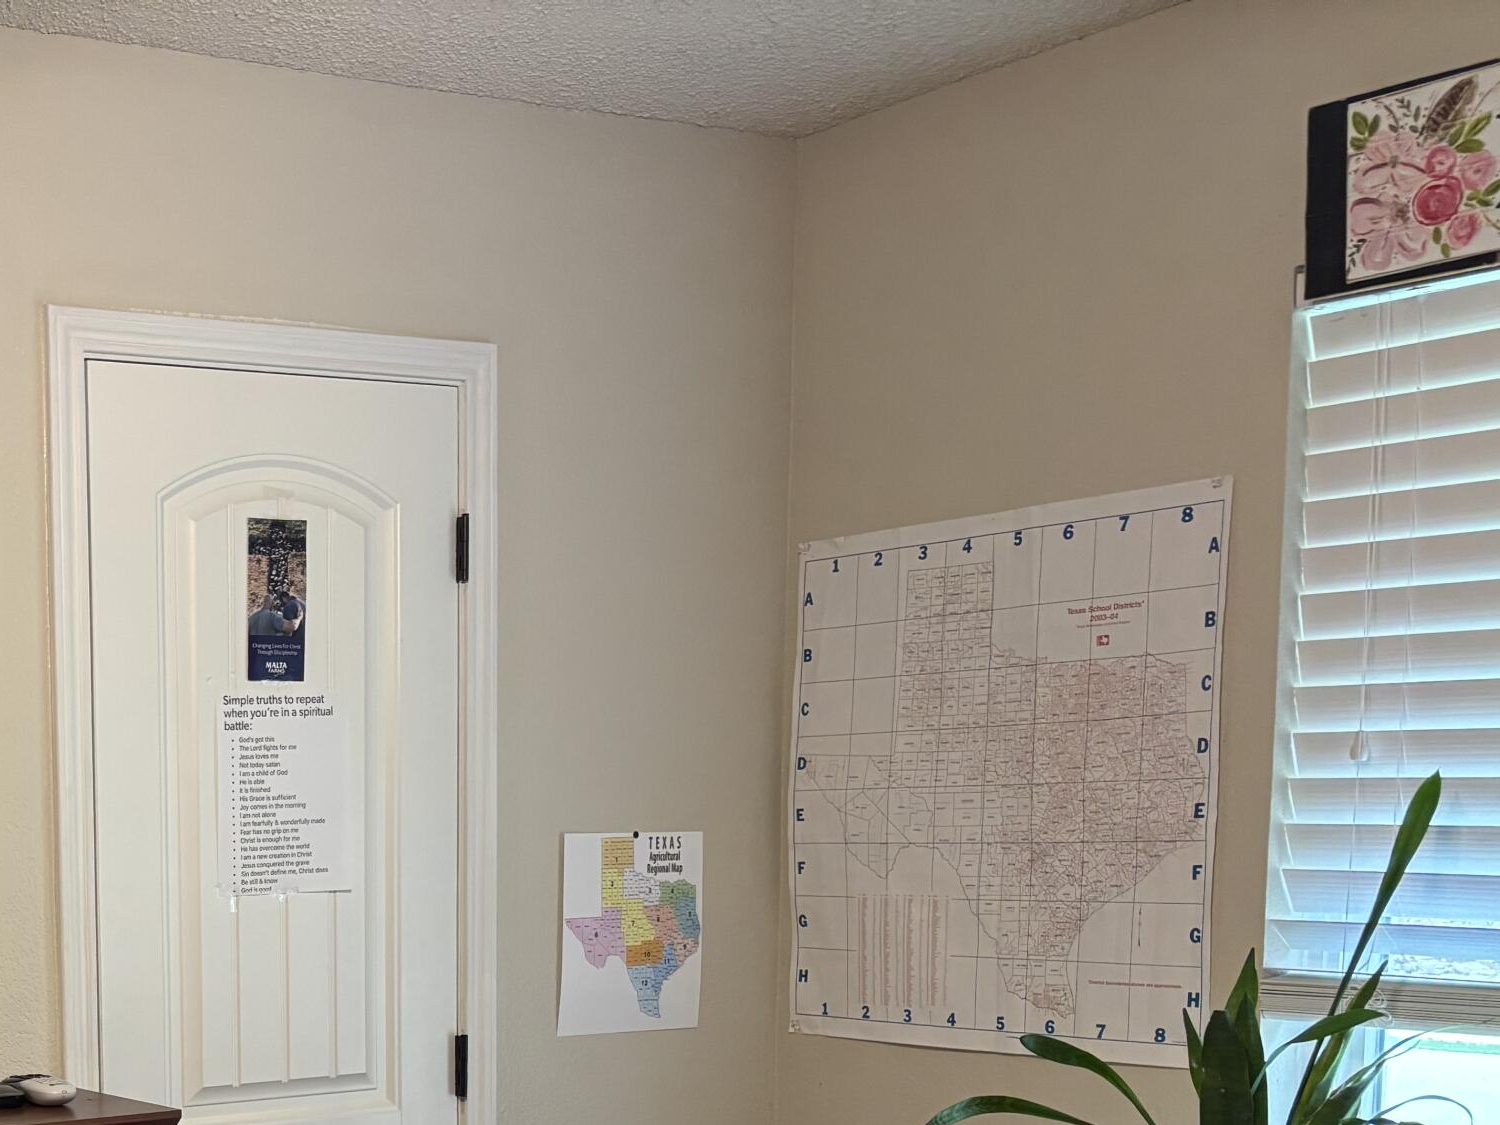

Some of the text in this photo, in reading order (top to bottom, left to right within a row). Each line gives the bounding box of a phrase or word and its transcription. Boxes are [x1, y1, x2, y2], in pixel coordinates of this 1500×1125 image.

[832, 506, 1194, 573] 1 2 3 4 5 6 7 8
[1208, 536, 1220, 554] A
[803, 592, 814, 607] A
[1088, 604, 1112, 612] School
[1204, 610, 1216, 628] B
[803, 648, 812, 663] B
[1201, 674, 1212, 691] C
[222, 694, 324, 707] Simple truths to repeat
[224, 708, 248, 718] when
[250, 708, 279, 720] you're
[281, 708, 289, 716] in
[299, 706, 334, 718] spiritual
[801, 702, 809, 717] C
[224, 721, 252, 730] battle:
[1196, 737, 1209, 754] D
[797, 756, 807, 771] D
[796, 808, 805, 822] E
[1193, 802, 1206, 819] E
[649, 836, 682, 850] TEXAS
[649, 851, 680, 864] Agricultural
[647, 864, 683, 876] Regional Map
[797, 861, 806, 875] F
[1192, 864, 1203, 881] F
[798, 914, 808, 928] G
[1189, 927, 1201, 944] G
[798, 969, 809, 983] H
[1187, 991, 1200, 1008] H
[822, 1002, 1166, 1043] 1 2 3 4 5 6 7 8
